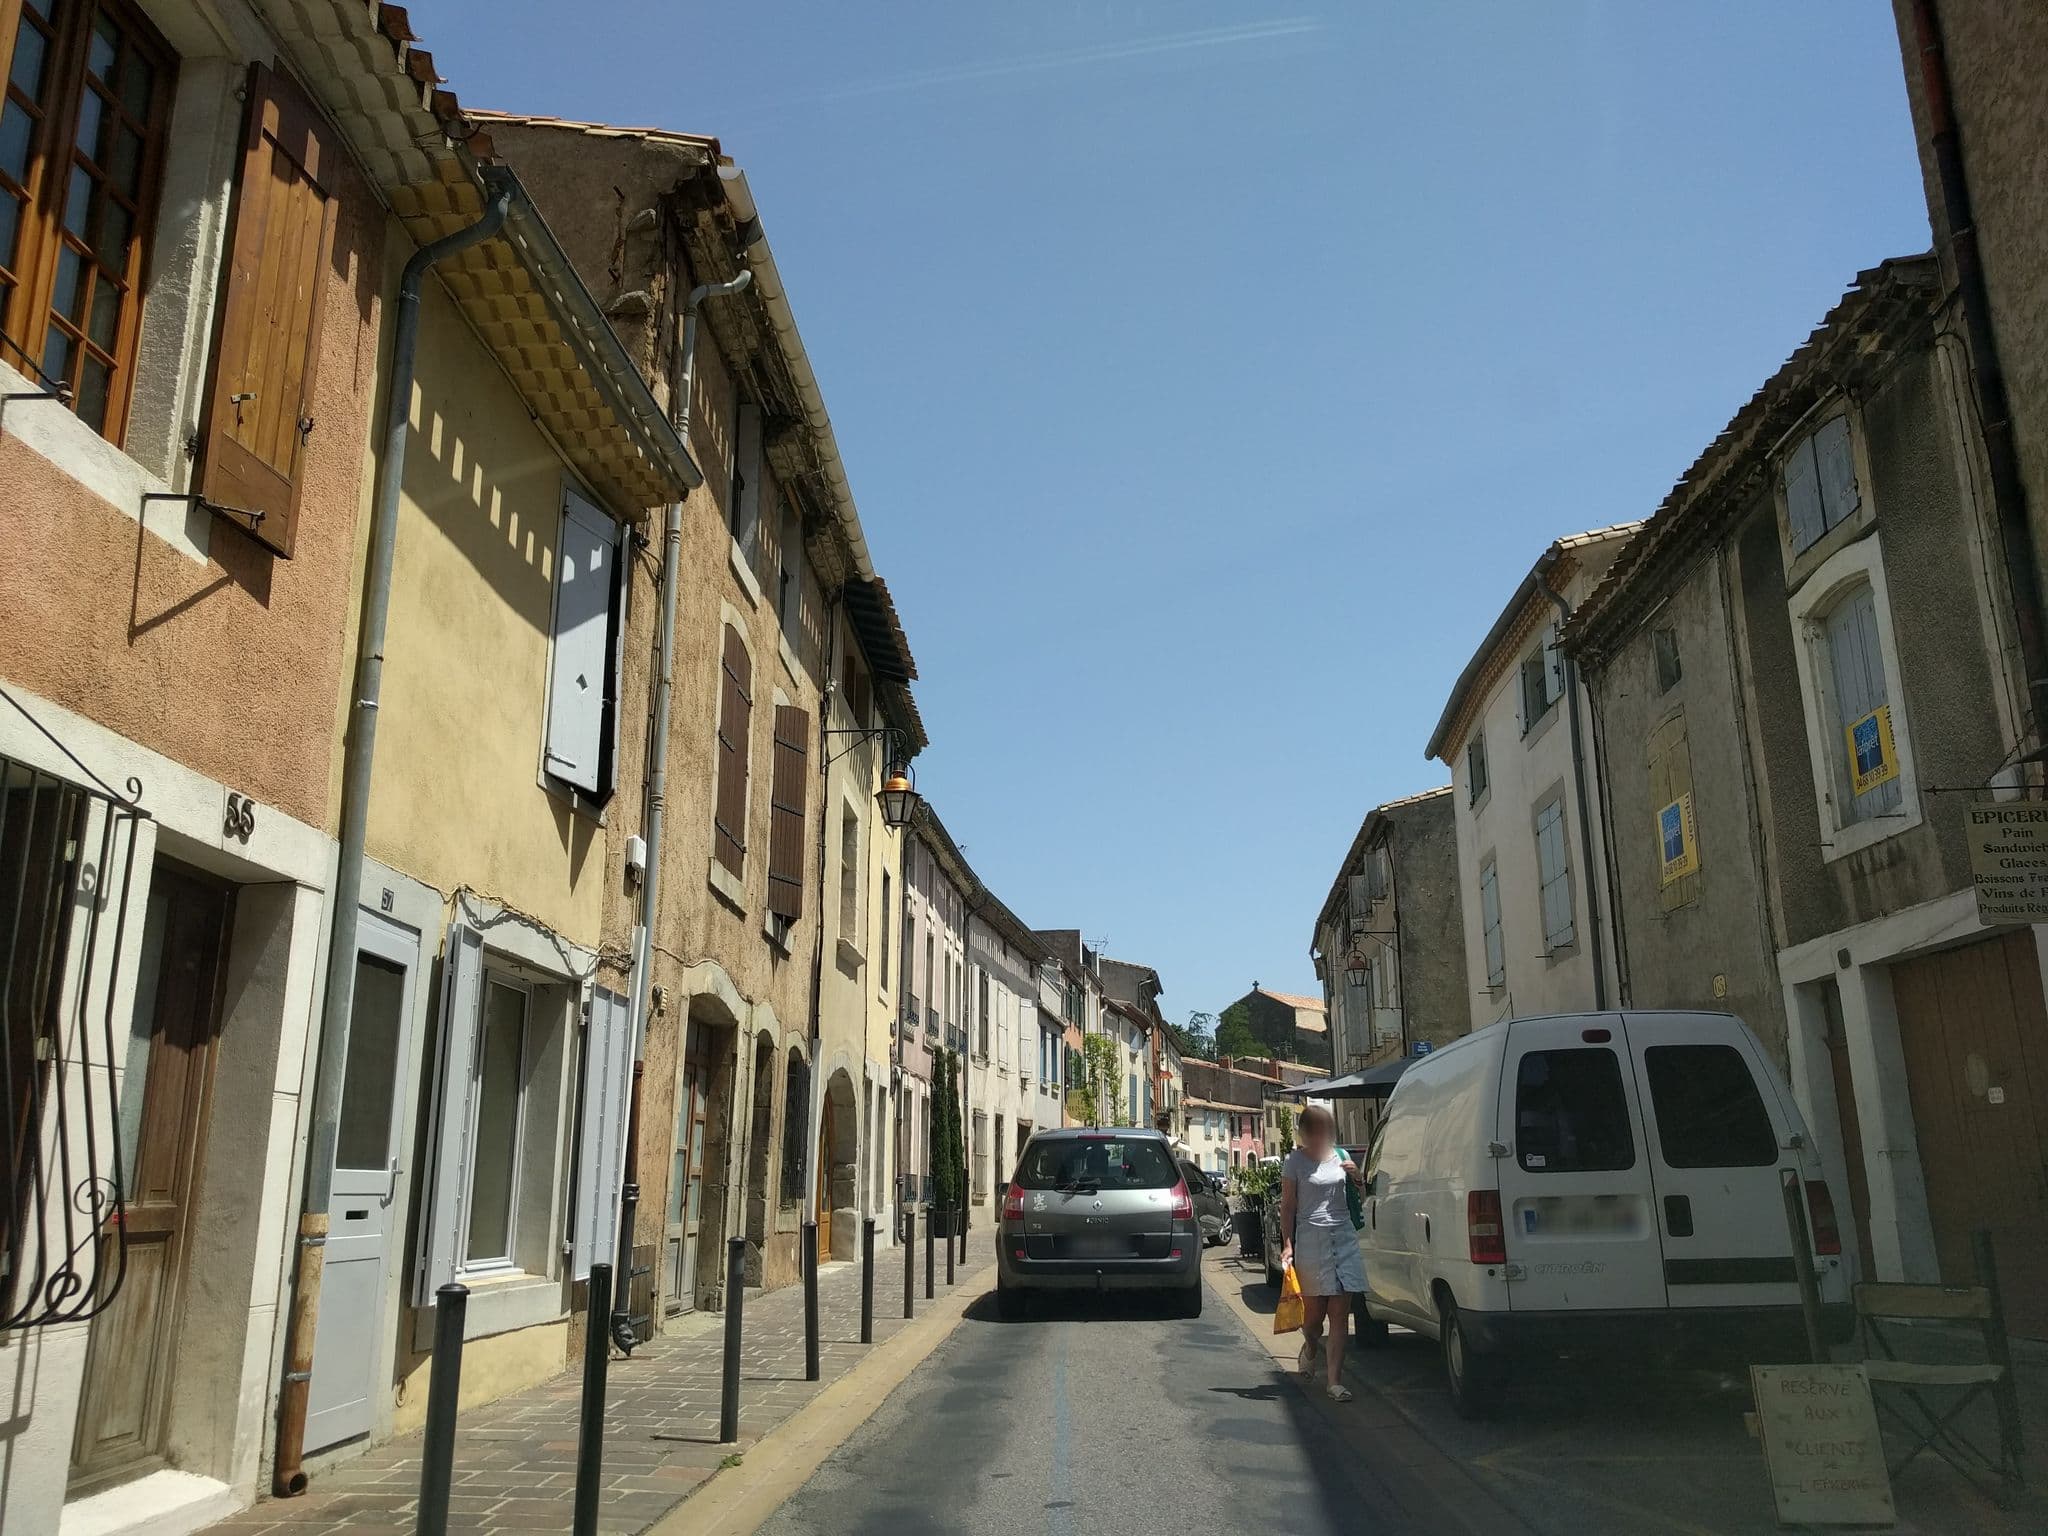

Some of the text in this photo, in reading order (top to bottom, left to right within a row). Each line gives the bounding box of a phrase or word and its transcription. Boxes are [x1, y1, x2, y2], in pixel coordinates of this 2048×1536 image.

[2001, 827, 2033, 839] Pain
[1999, 858, 2047, 869] Glaces
[1974, 874, 2024, 884] Boissons
[1981, 888, 2013, 899] Vins
[2019, 888, 2035, 898] de
[382, 889, 394, 910] 57
[1979, 903, 2025, 914] Produits
[1805, 1406, 1839, 1420] AUX
